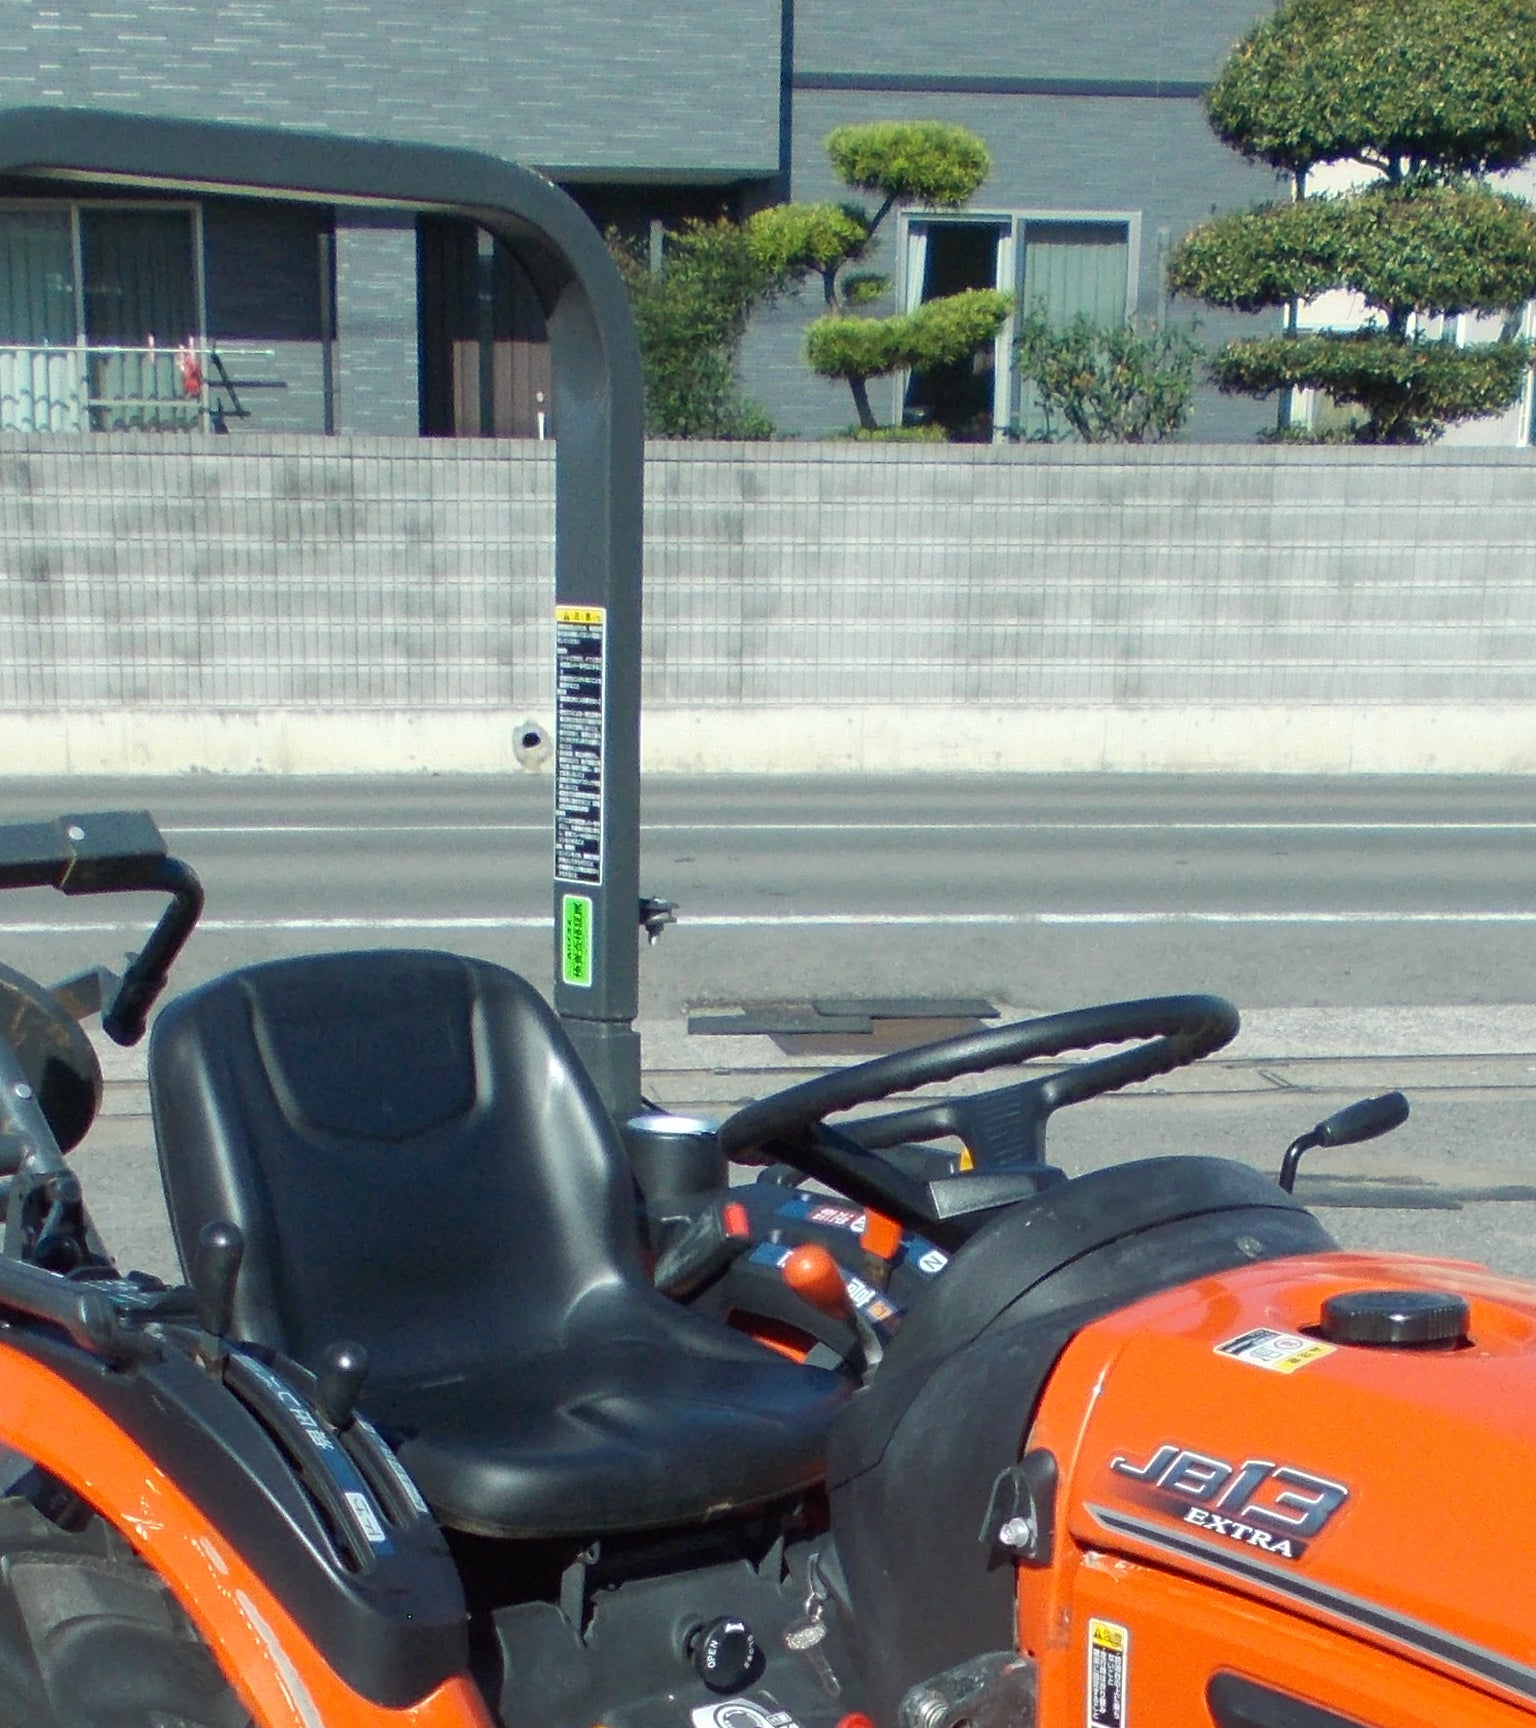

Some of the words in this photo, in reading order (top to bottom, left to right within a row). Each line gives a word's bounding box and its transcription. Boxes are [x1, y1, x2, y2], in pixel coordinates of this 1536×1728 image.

[1109, 1445, 1349, 1537] JB13
[1183, 1506, 1294, 1559] EXTRA
[706, 1639, 720, 1669] OPEN
